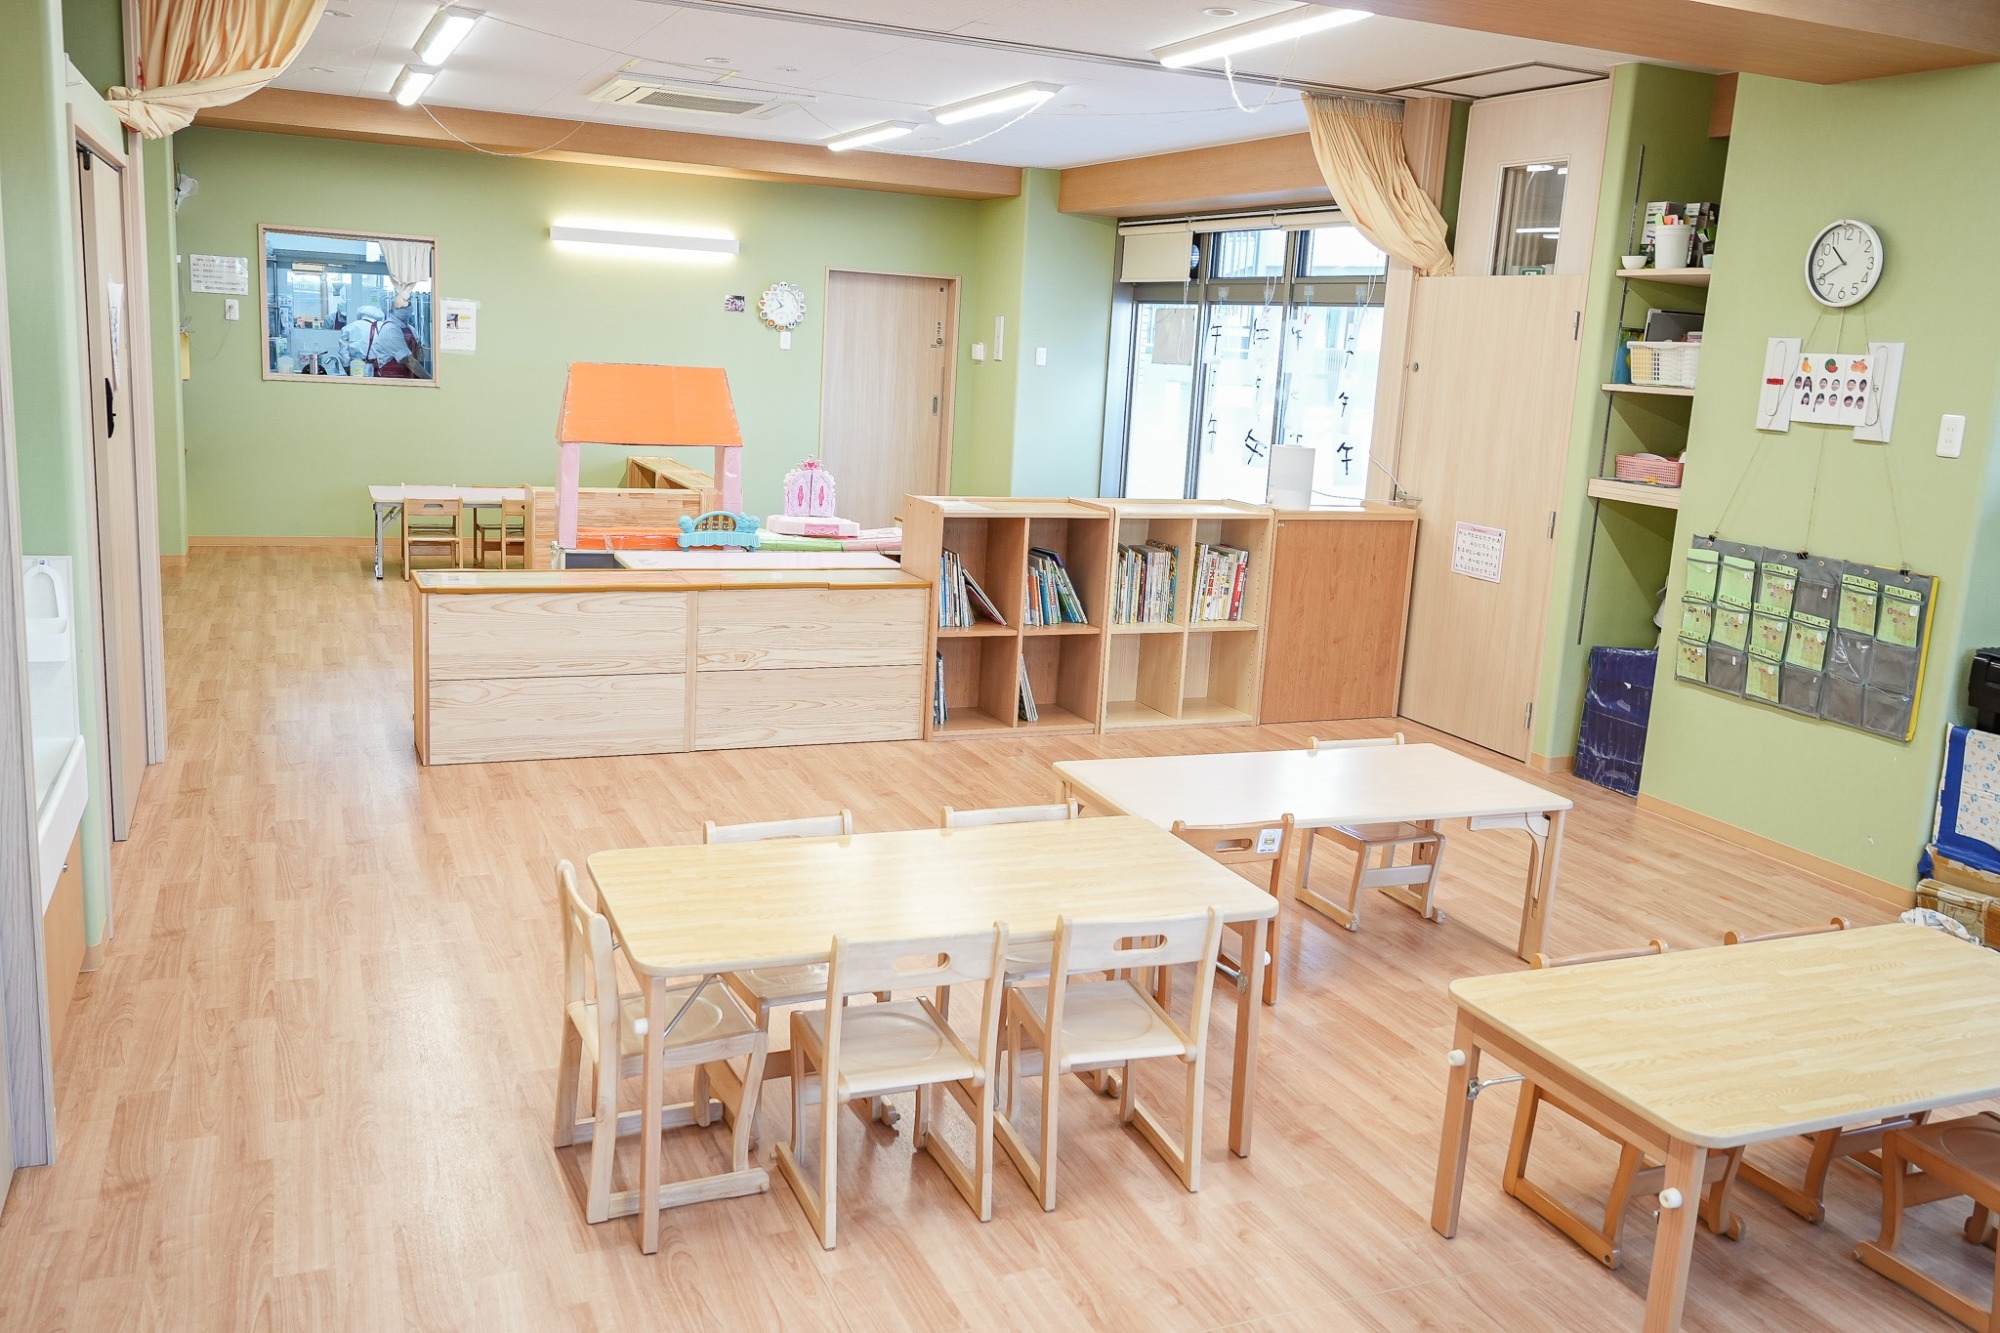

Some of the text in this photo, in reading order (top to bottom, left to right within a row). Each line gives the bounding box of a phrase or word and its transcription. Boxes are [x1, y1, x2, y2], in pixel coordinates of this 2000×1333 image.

[1832, 232, 1840, 245] 11
[1844, 227, 1854, 240] 12
[1821, 243, 1831, 256] 10
[1864, 239, 1872, 253] 2
[1817, 258, 1825, 271] 9
[1866, 256, 1874, 270] 3
[1861, 272, 1868, 282] 4
[1827, 283, 1835, 297] 7
[1838, 287, 1845, 299] 6
[1851, 283, 1858, 295] 5
